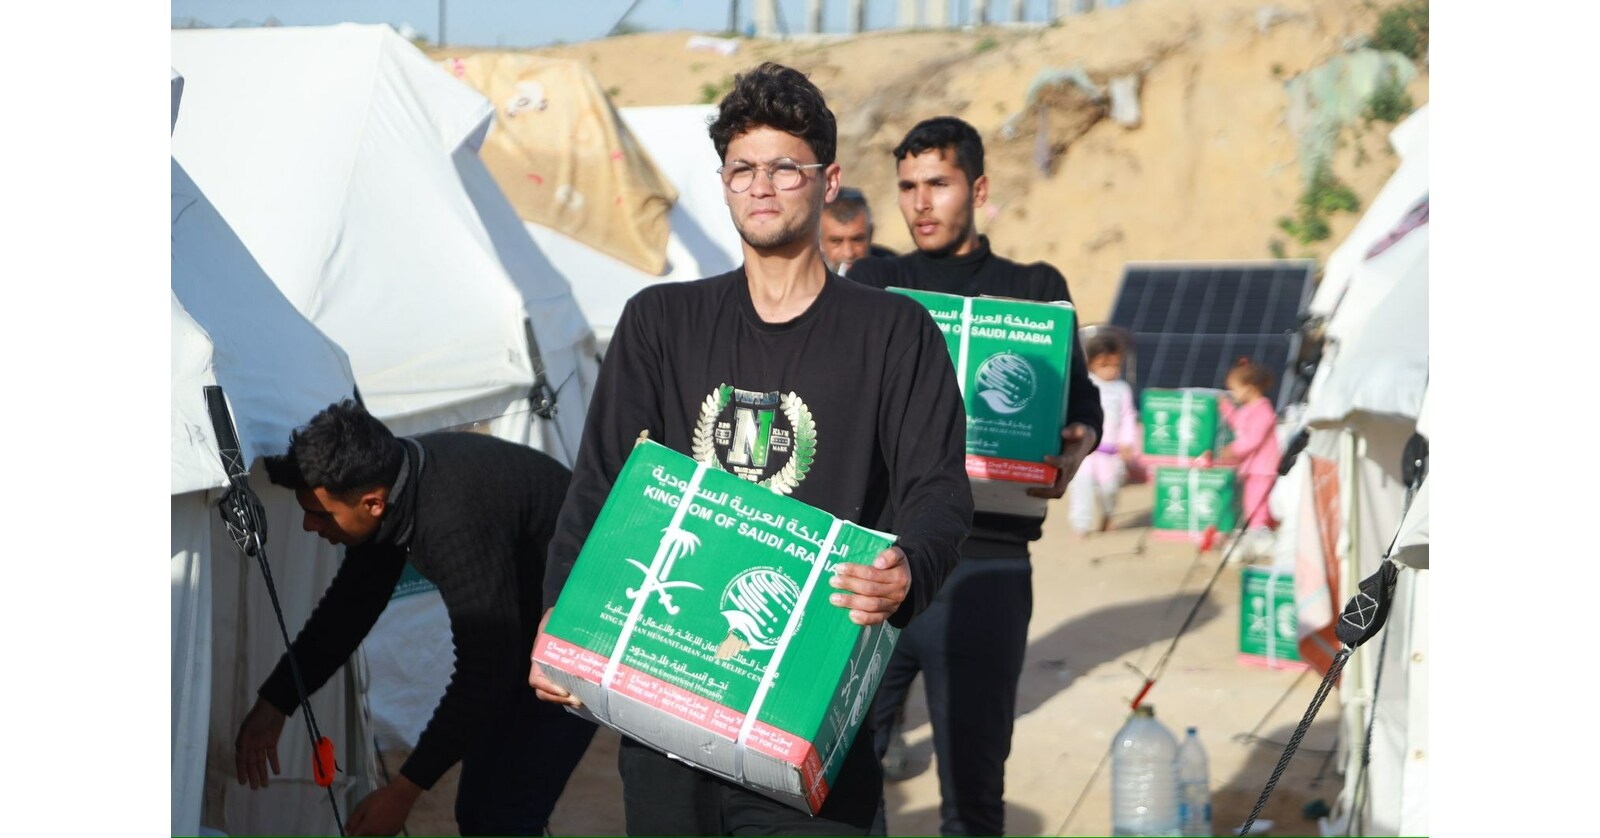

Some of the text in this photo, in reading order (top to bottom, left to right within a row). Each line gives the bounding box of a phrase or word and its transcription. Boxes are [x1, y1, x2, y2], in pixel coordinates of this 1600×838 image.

[970, 326, 1006, 340] SAUDI
[1008, 330, 1053, 345] ARABIA
[1003, 312, 1054, 331] المملكة
[727, 406, 775, 467] N
[729, 496, 785, 529] العربية
[643, 484, 838, 577] KINGOM OF SAUDI ARAIA
[543, 649, 561, 660] FREE
[560, 655, 576, 666] GIFT
[577, 663, 592, 673] NOT
[599, 611, 619, 624] KING
[646, 630, 701, 657] HUMANITARIAN
[700, 653, 715, 663] AID
[721, 660, 747, 676] RELIEF
[746, 672, 776, 689] CENR
[628, 645, 657, 660] حدود
[706, 676, 730, 691] نحو
[626, 683, 643, 695] FREE
[661, 697, 677, 707] NOT
[675, 702, 689, 713] FOR
[689, 708, 706, 720] SALE
[710, 719, 728, 730] FREE
[760, 738, 773, 749] FOR
[772, 744, 790, 756] SALE
